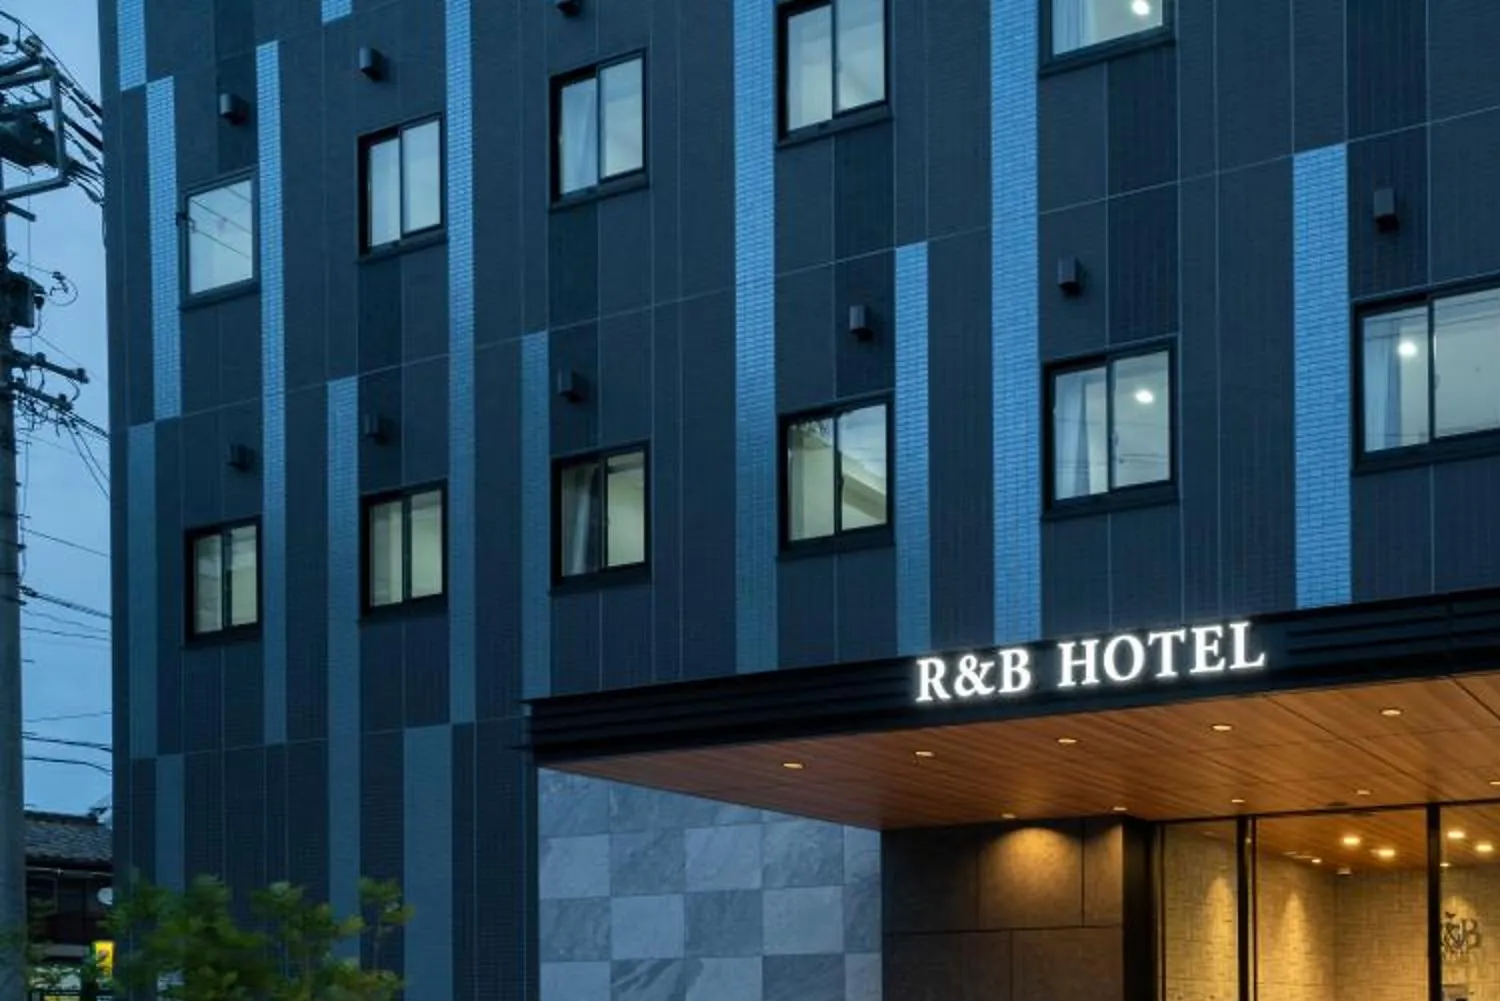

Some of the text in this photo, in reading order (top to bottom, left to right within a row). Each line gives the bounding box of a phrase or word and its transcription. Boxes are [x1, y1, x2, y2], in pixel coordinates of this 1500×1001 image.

[915, 622, 1265, 702] R&B HOTEL
[1440, 918, 1482, 950] &B
